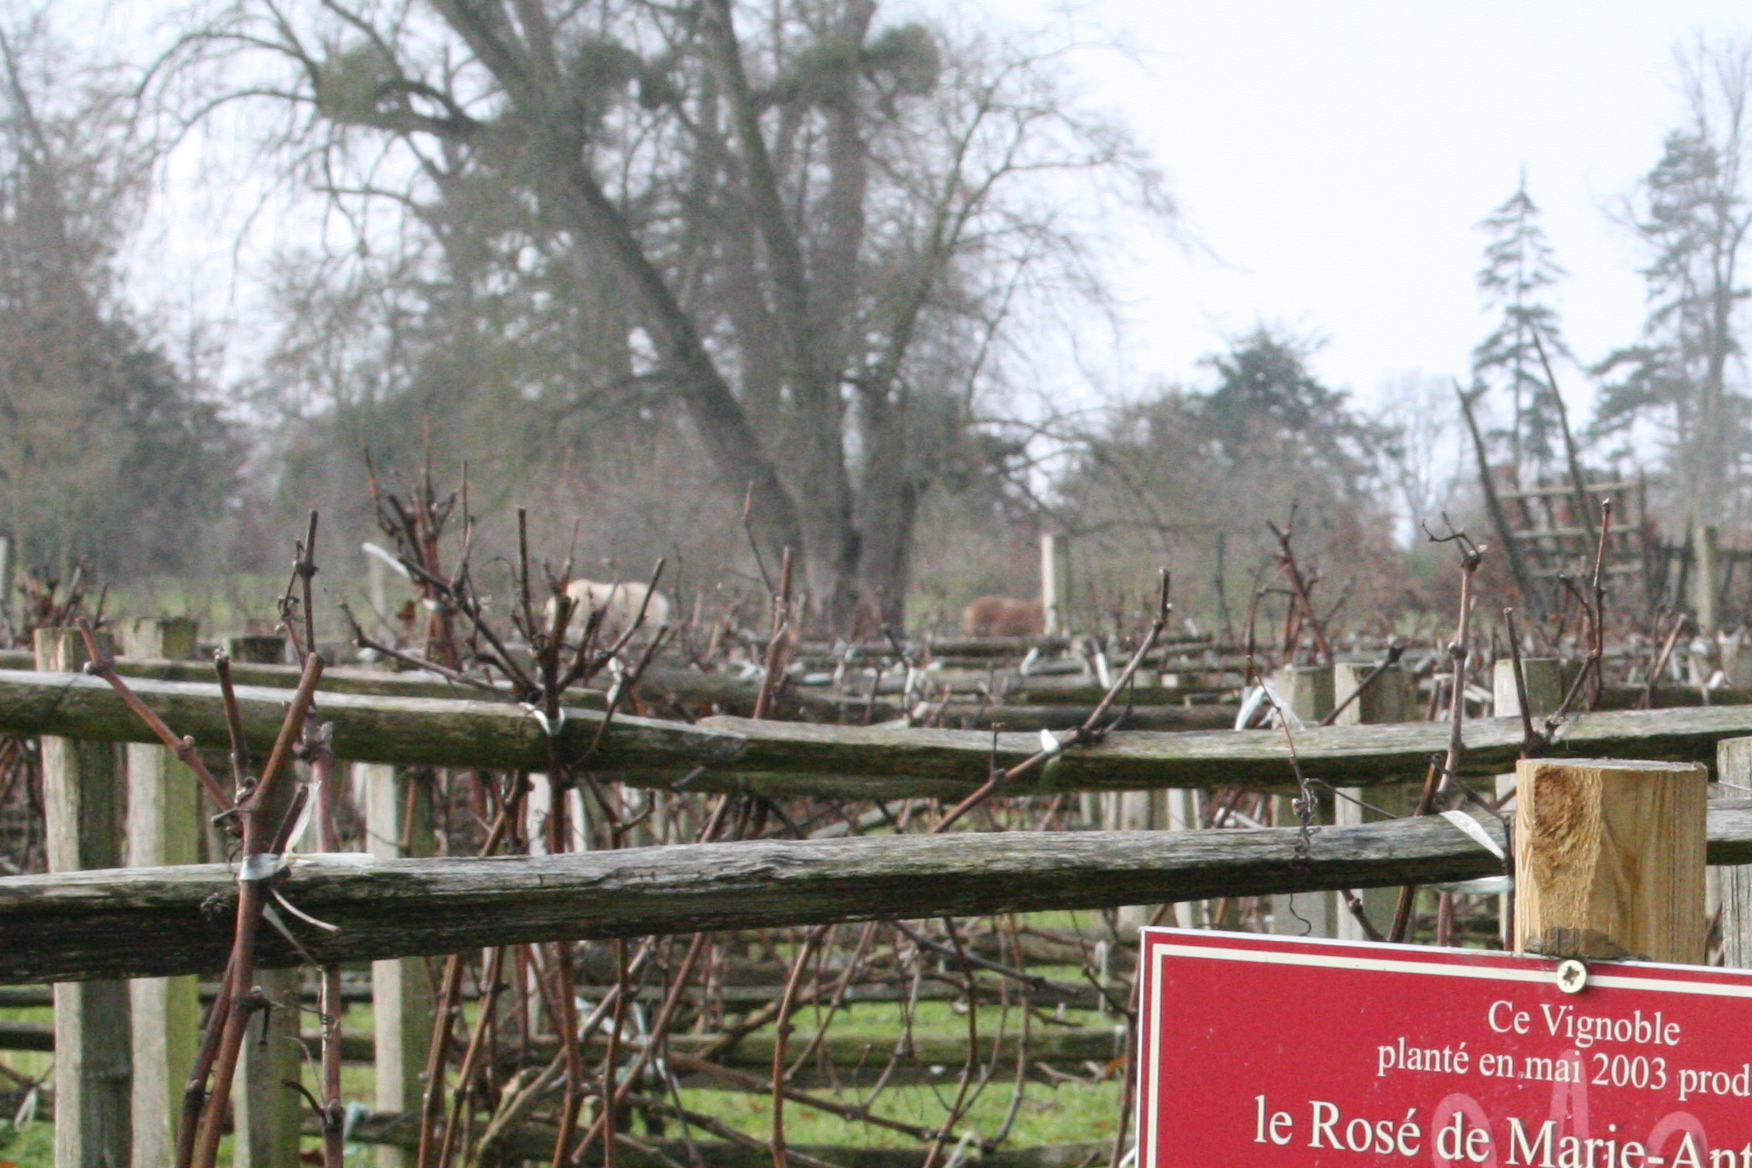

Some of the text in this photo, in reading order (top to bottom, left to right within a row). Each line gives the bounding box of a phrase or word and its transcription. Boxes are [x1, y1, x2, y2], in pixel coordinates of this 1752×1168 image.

[1488, 1000, 1681, 1046] Ce Vignoble
[1377, 1037, 1469, 1076] planté
[1478, 1052, 1515, 1078] en
[1524, 1049, 1581, 1085] mai
[1592, 1052, 1668, 1090] 2003
[1255, 1095, 1293, 1145] le
[1308, 1100, 1421, 1158] Rosé
[1437, 1111, 1490, 1163] de
